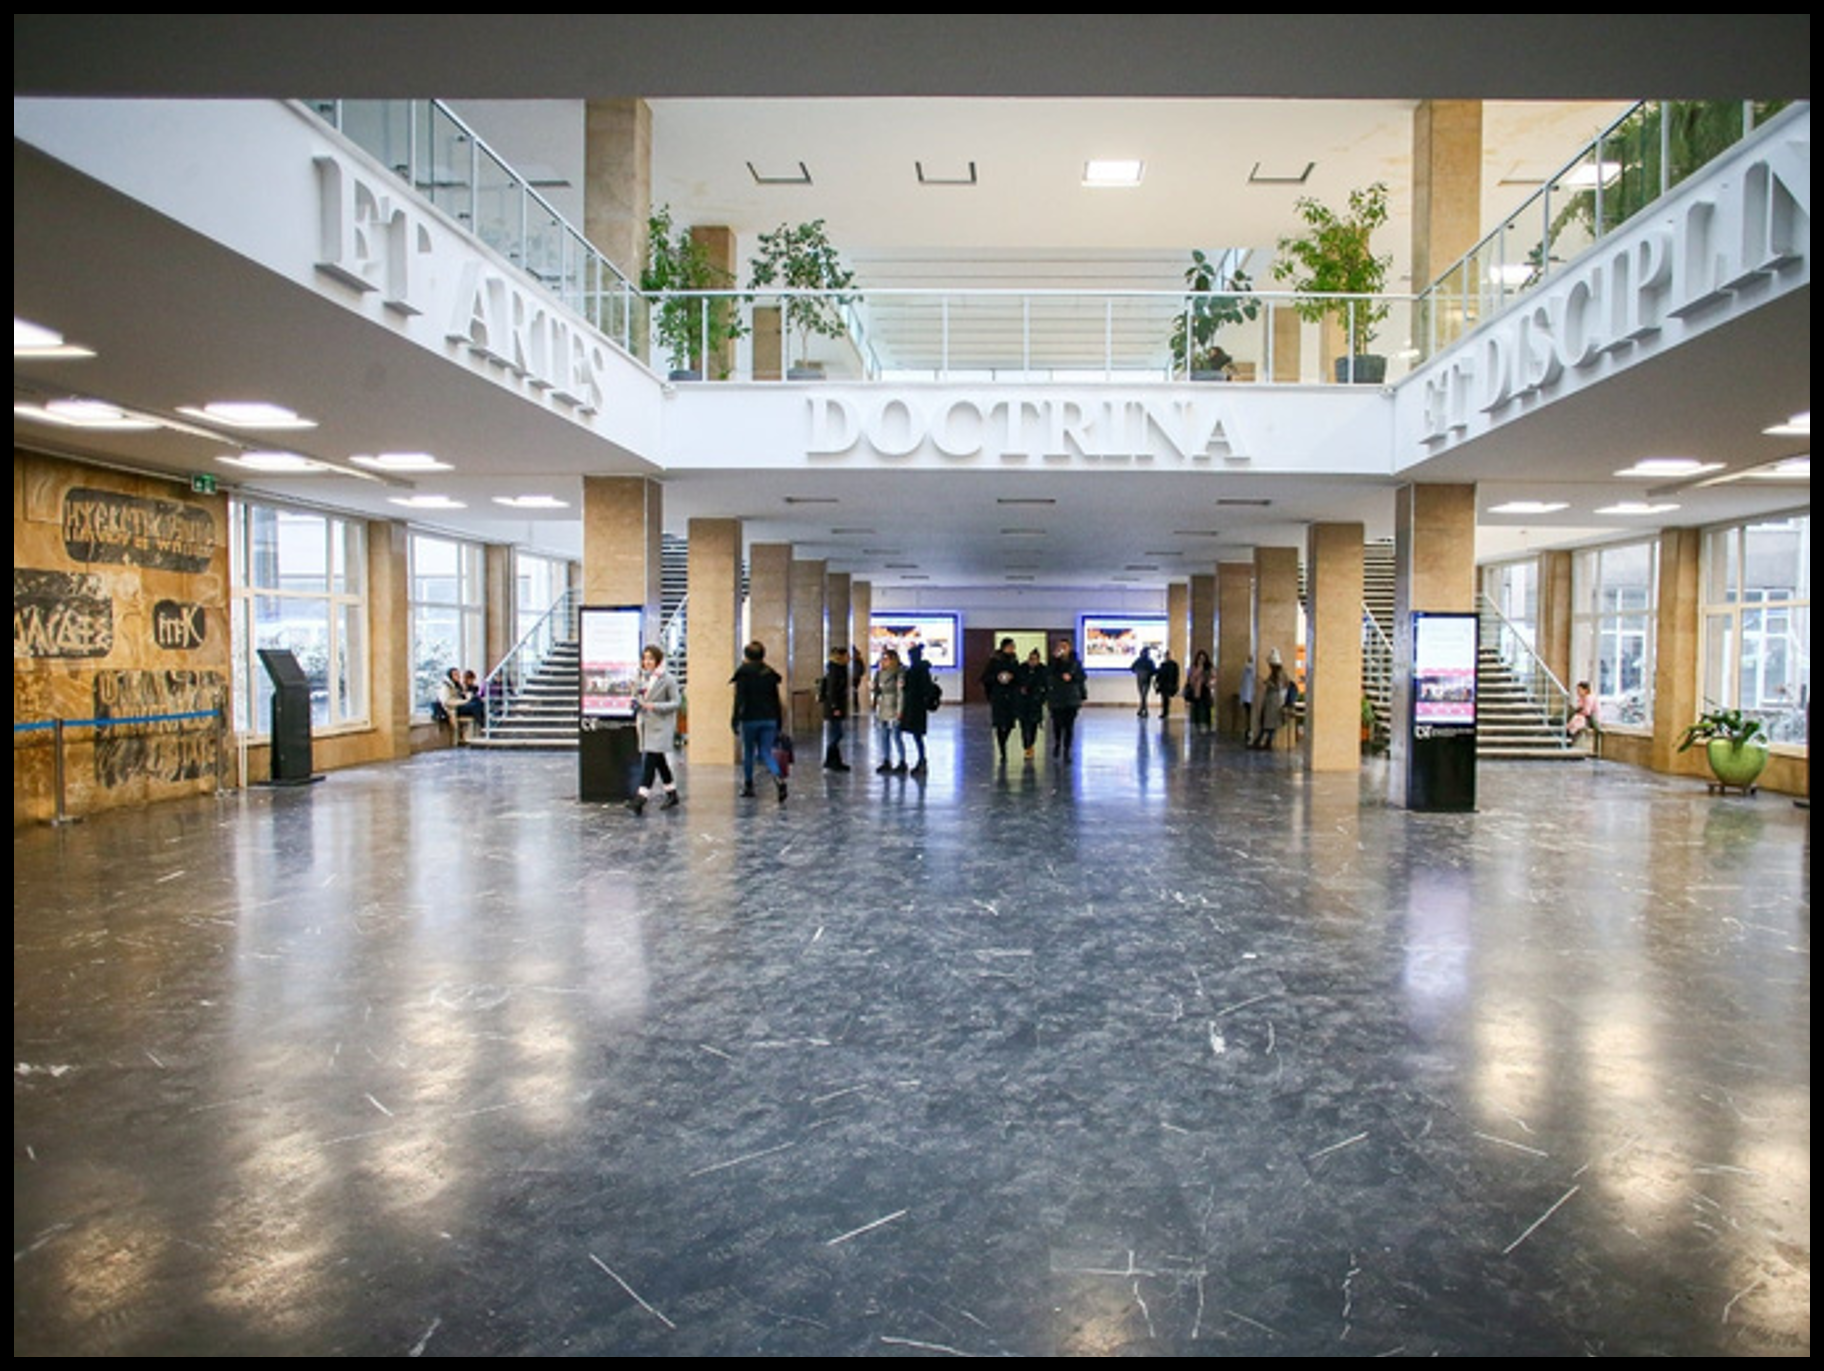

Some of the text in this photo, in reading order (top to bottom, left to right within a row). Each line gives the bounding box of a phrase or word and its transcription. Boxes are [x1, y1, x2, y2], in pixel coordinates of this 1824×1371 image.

[312, 155, 605, 416] ET ARTES
[805, 398, 1252, 463] DOCTRINA
[1419, 354, 1476, 446] ET
